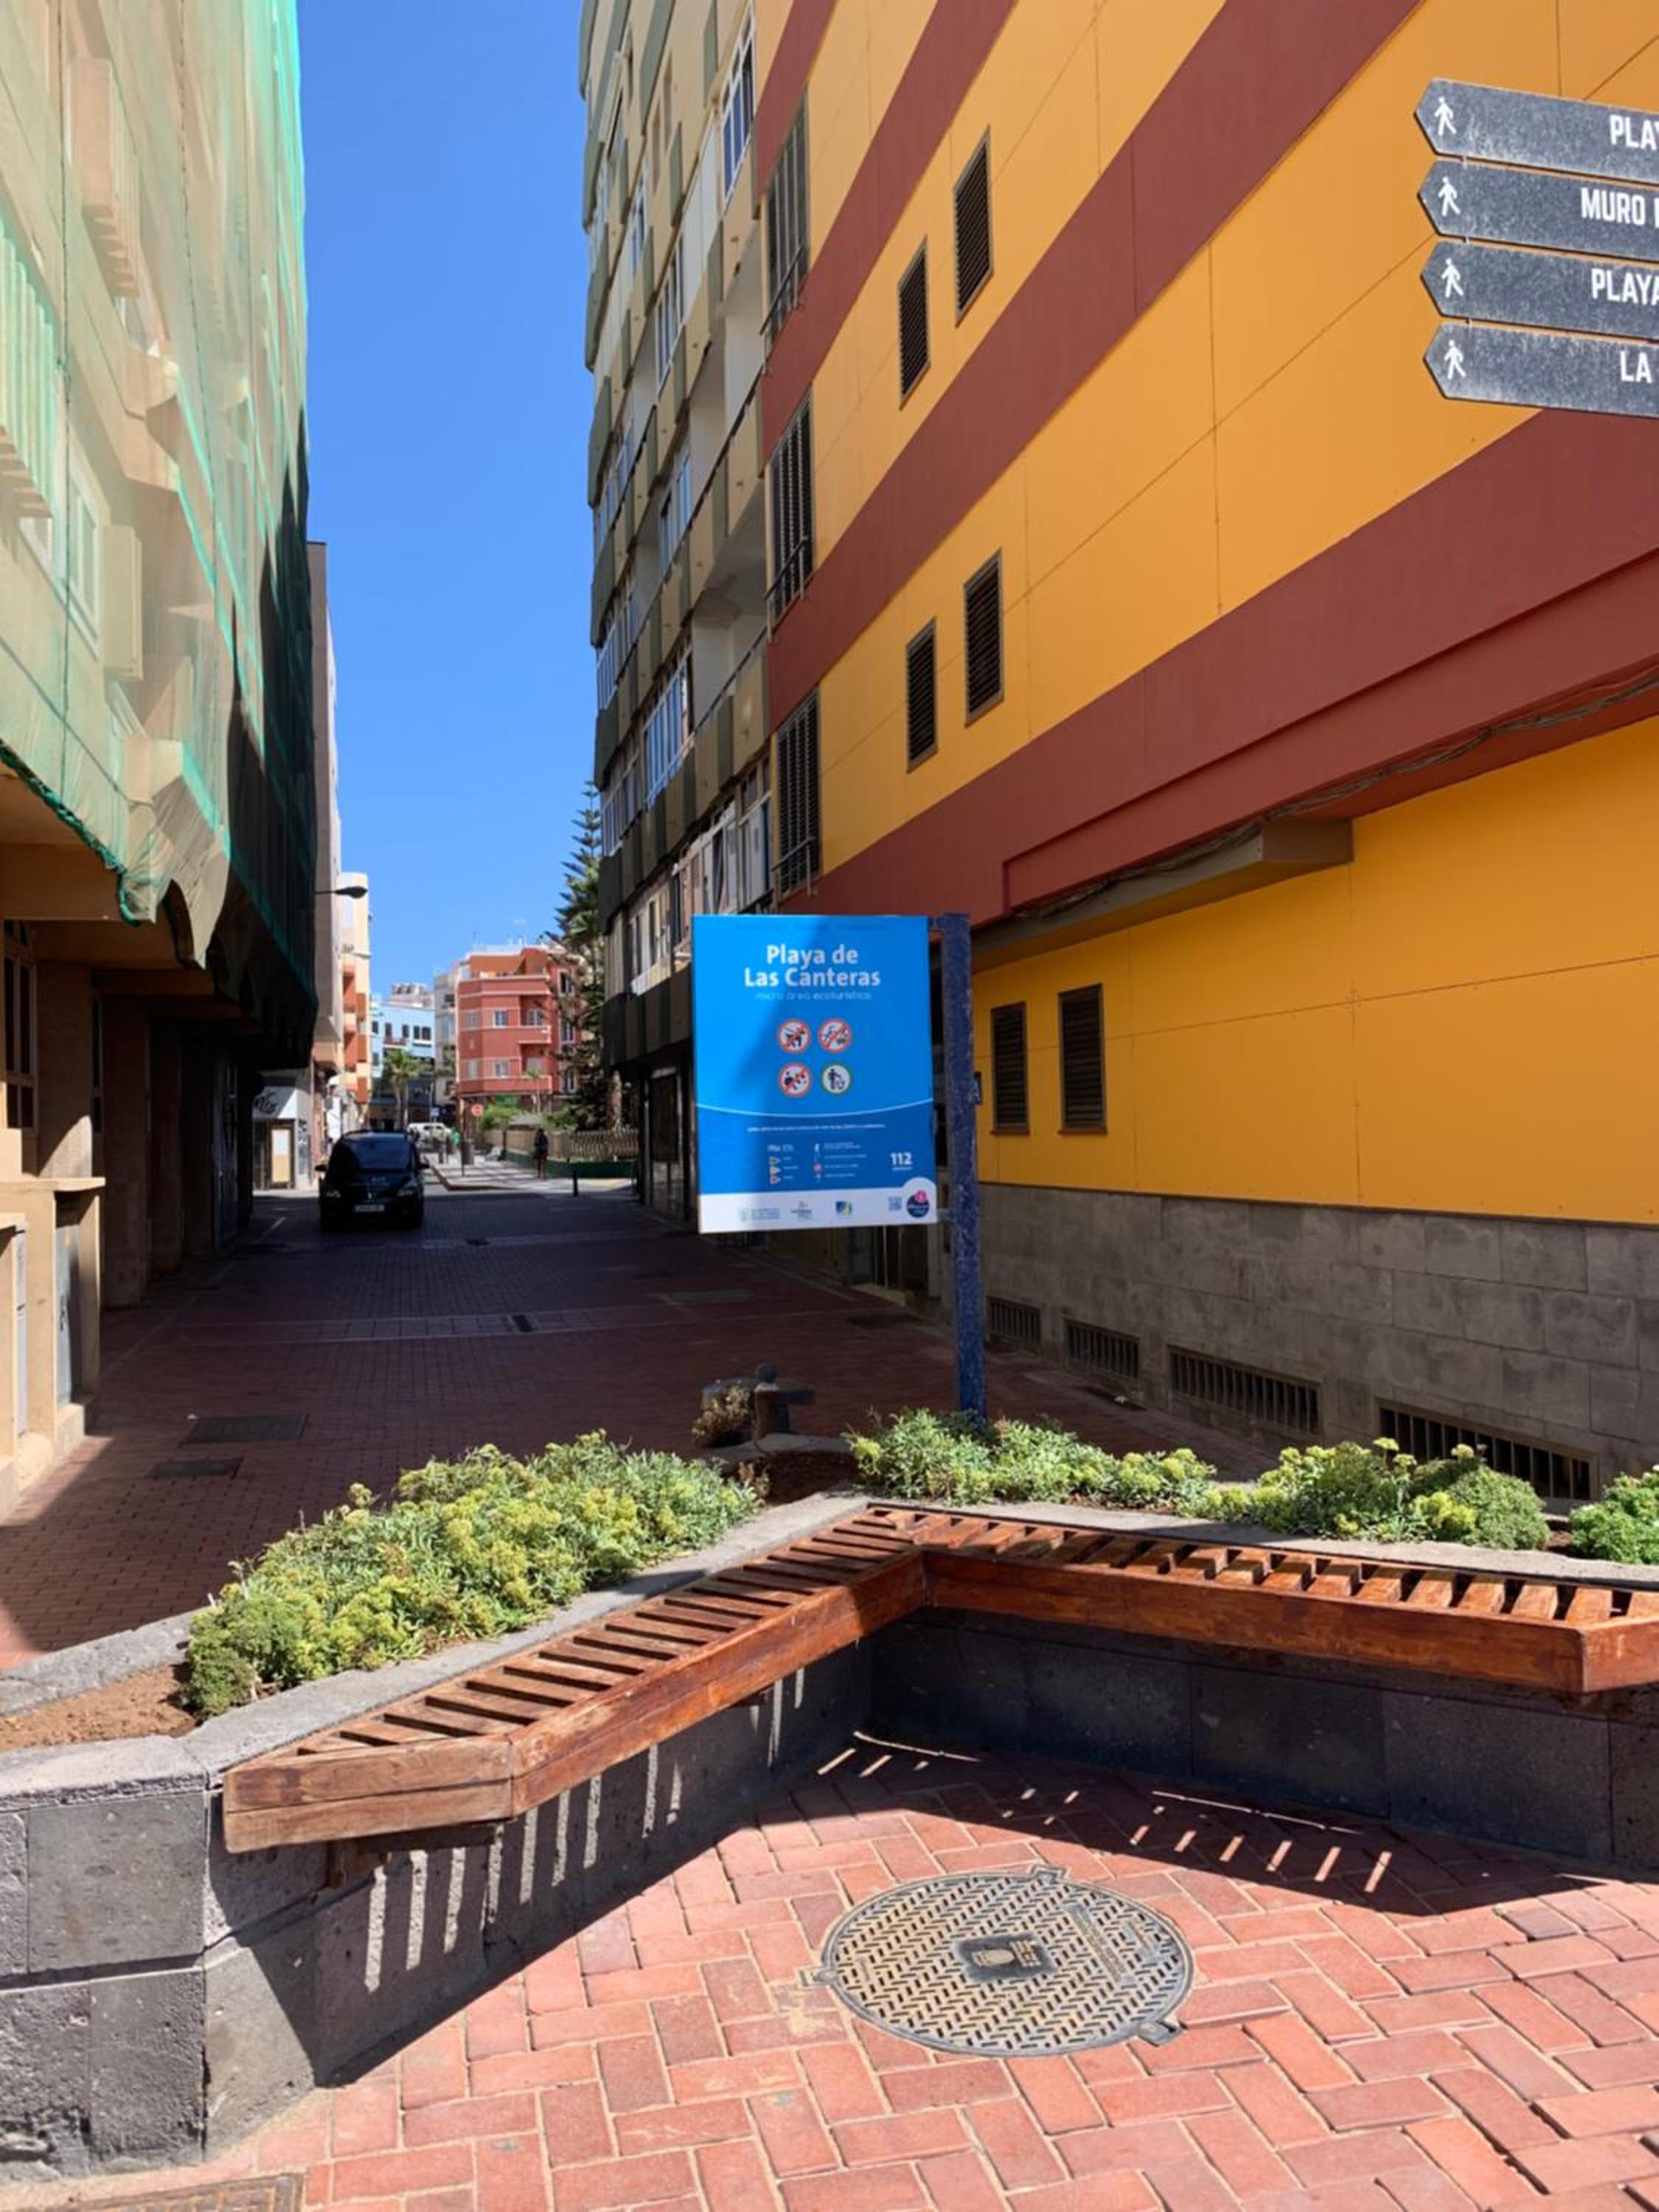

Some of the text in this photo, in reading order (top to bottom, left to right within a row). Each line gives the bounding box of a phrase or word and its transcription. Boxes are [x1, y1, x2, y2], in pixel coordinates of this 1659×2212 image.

[1581, 187, 1646, 226] MURO
[1620, 350, 1652, 383] LA
[766, 943, 859, 970] Playa de
[745, 967, 881, 987] Las Canteras
[890, 1152, 913, 1166] 112
